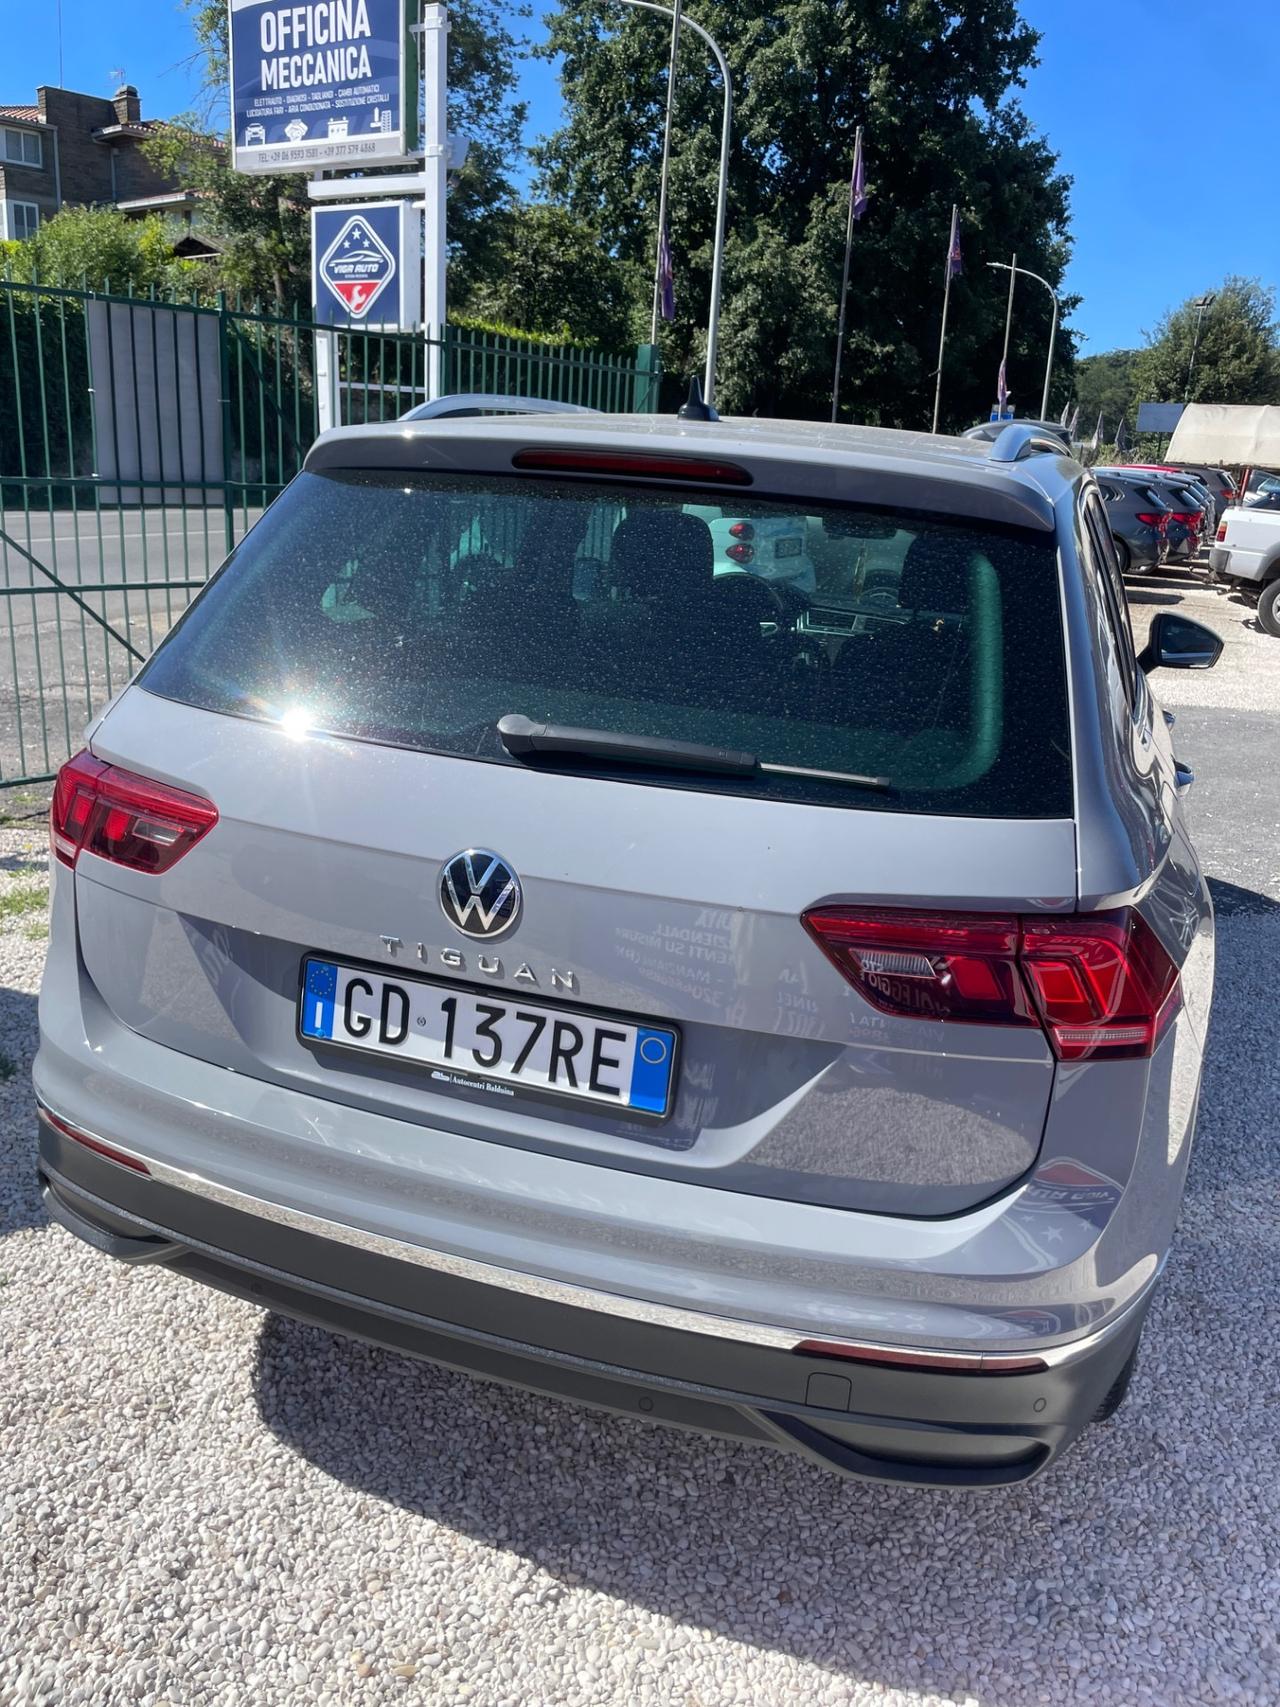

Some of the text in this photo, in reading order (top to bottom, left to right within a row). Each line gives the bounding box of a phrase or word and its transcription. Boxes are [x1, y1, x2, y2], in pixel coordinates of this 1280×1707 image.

[260, 0, 372, 53] OFFICINA
[261, 44, 373, 91] MECCANICA
[354, 263, 380, 273] AUTO
[379, 934, 576, 990] TIGUAN
[343, 977, 410, 1046] GD
[440, 996, 628, 1097] 137RE
[452, 1075, 485, 1090] Autocentri
